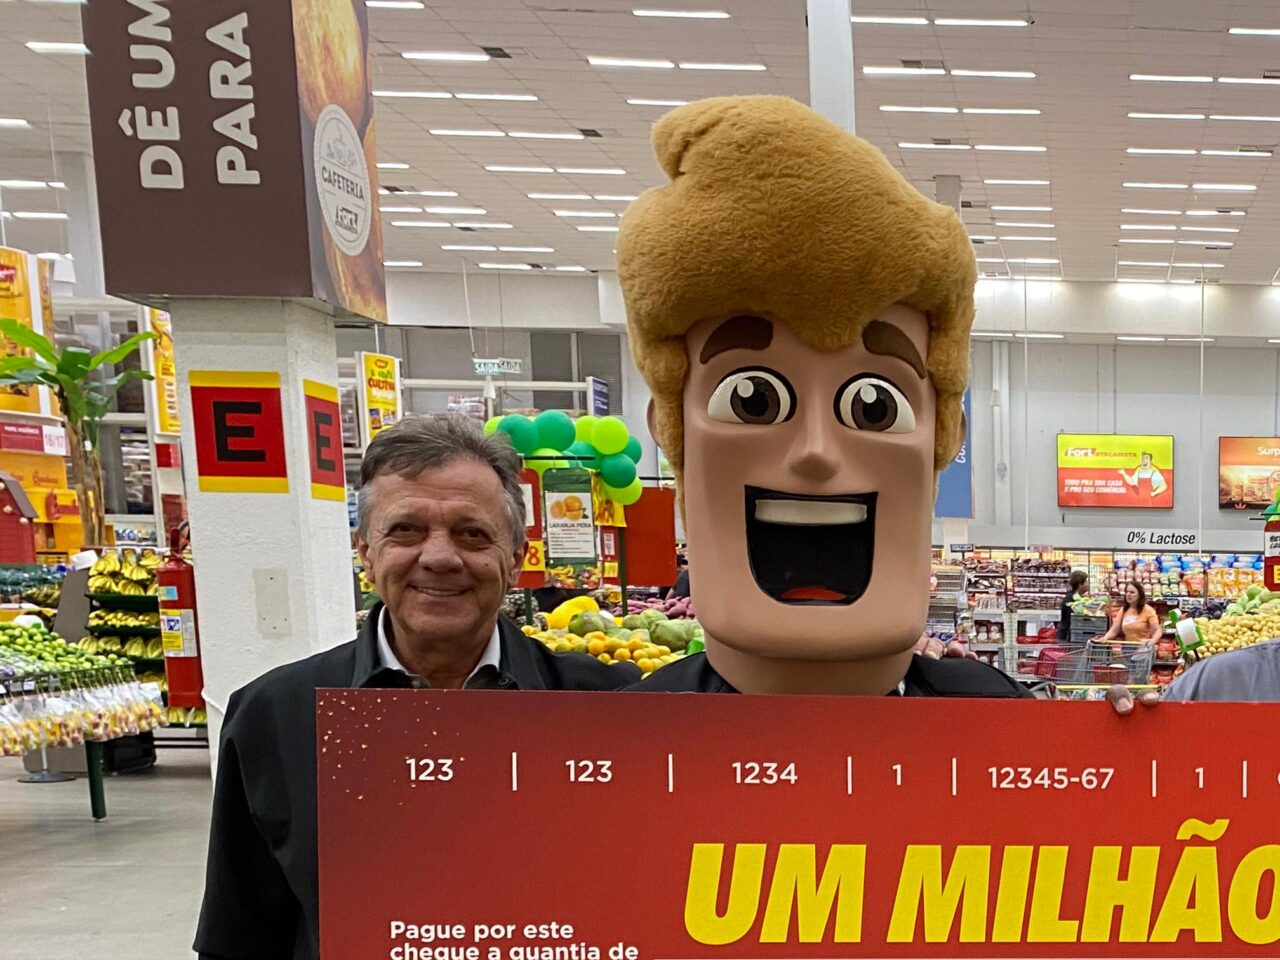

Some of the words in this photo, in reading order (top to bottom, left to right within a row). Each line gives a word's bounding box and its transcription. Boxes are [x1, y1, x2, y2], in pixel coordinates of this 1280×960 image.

[206, 12, 260, 184] PARA
[118, 106, 184, 189] DÊ
[321, 166, 365, 200] CAFETERIA
[475, 362, 499, 374] SAÍDA
[213, 401, 266, 462] E
[314, 410, 336, 472] E
[1127, 531, 1146, 544] 0%
[1149, 532, 1196, 545] Lactose
[406, 758, 454, 782] 123
[565, 759, 613, 783] 123
[732, 762, 798, 785] 1234
[892, 764, 902, 786] 1
[988, 767, 1115, 790] 12345-67
[1194, 767, 1205, 789] 1
[684, 843, 867, 946] UM
[390, 921, 466, 943] Pague
[474, 924, 516, 943] por
[523, 922, 574, 939] este
[487, 946, 501, 960] a
[608, 942, 639, 960] de
